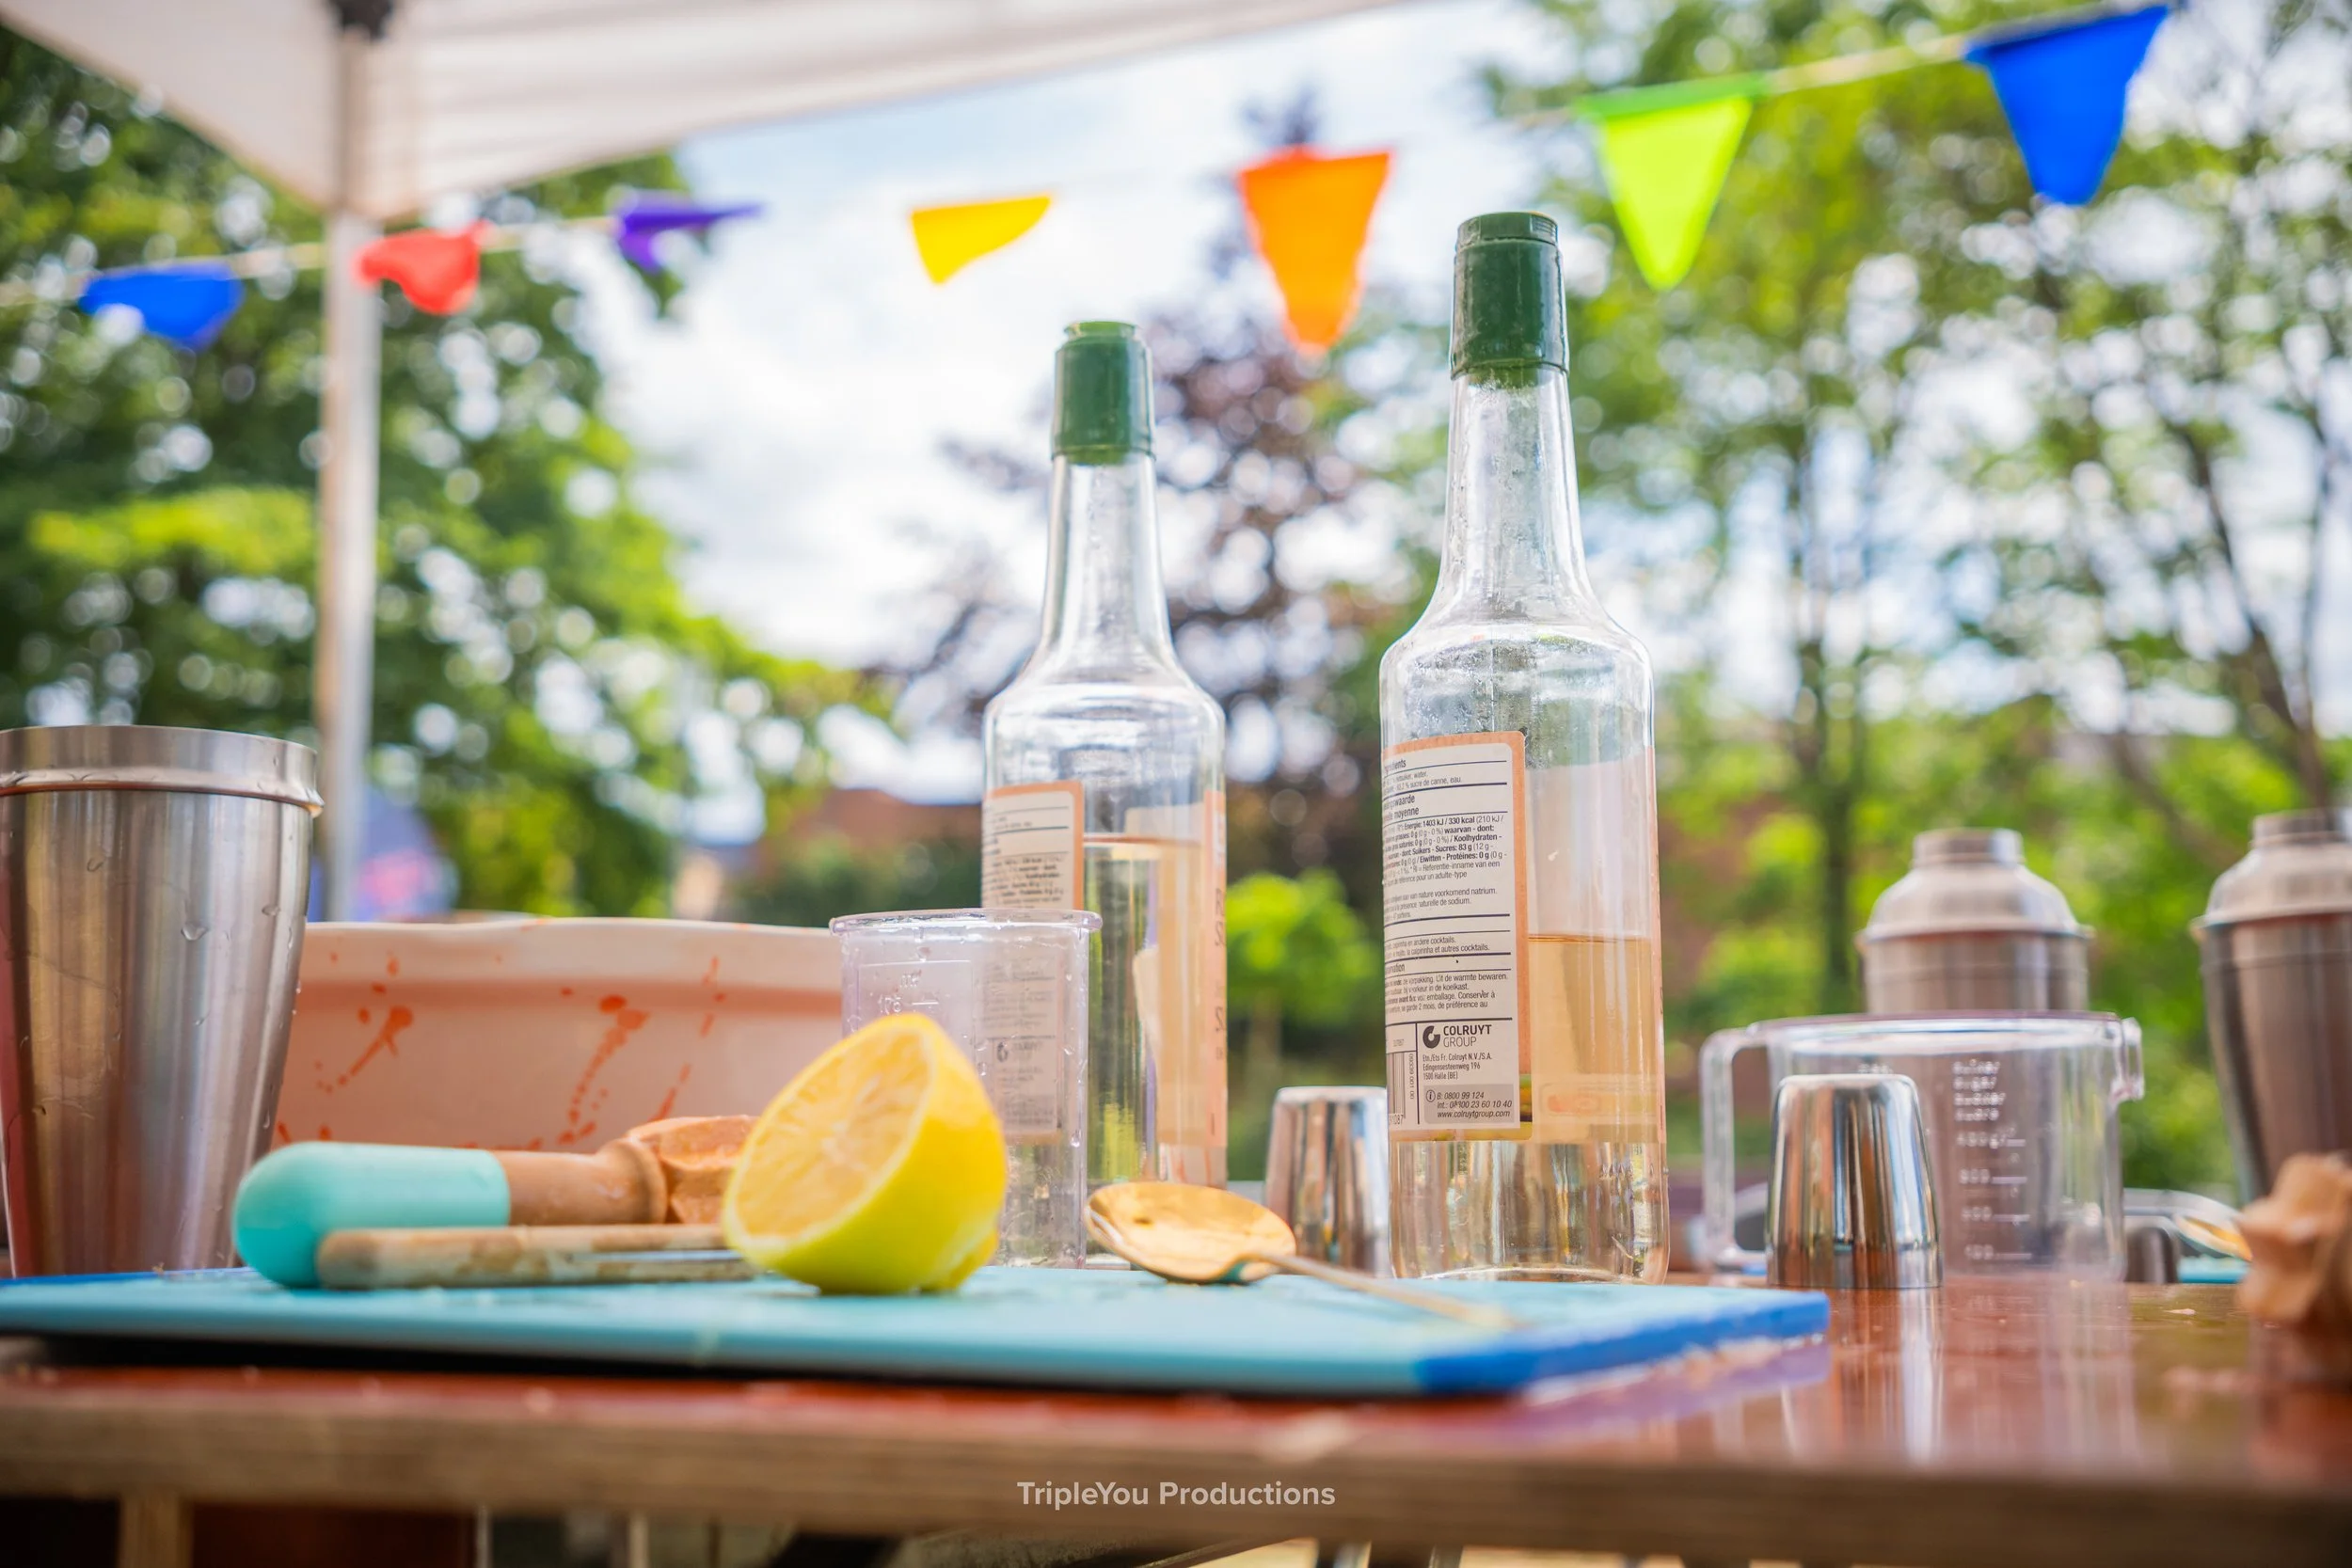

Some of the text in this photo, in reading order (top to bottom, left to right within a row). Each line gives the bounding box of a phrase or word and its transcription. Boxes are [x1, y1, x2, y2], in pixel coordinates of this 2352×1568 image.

[1394, 807, 1419, 820] moyenne
[1434, 888, 1470, 896] voorkomend
[1427, 993, 1456, 1001] emballage.
[1443, 1025, 1492, 1036] COLRUYT
[1443, 1036, 1476, 1047] GROUP
[1448, 1053, 1467, 1062] Colruyt
[1437, 1110, 1510, 1119] www.colruytgroup.com
